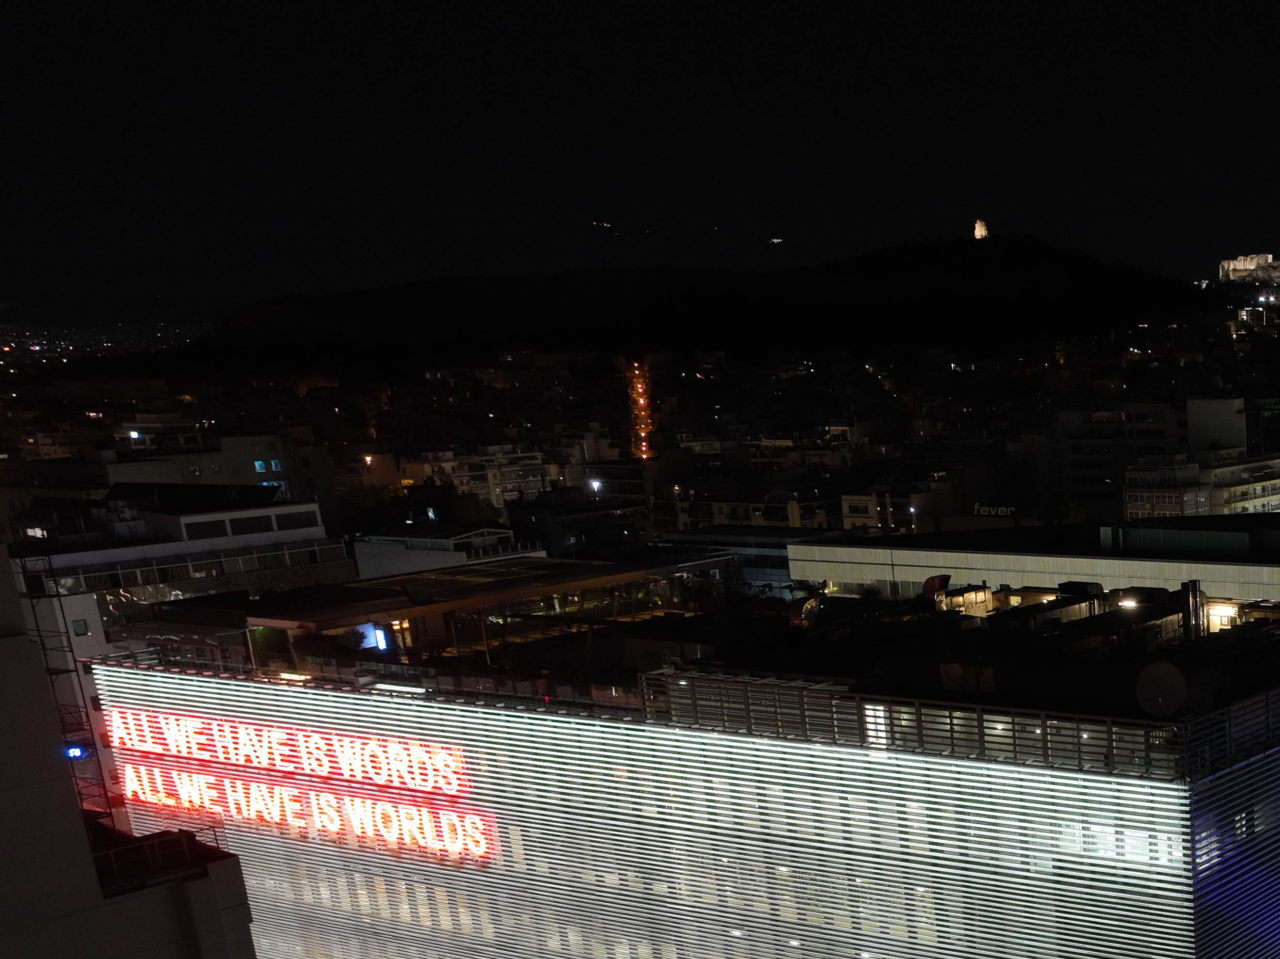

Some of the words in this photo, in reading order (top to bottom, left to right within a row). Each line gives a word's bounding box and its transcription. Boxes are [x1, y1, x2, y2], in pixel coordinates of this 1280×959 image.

[973, 502, 1016, 516] fever
[111, 710, 163, 752] ALL
[159, 715, 210, 760] WE
[212, 722, 295, 771] HAVE
[299, 733, 330, 776] IS
[332, 738, 459, 795] WORDS
[125, 763, 176, 806] ALL
[172, 770, 224, 813] WE
[223, 778, 307, 827] HAVE
[309, 790, 341, 832] IS
[343, 795, 488, 855] WORLDS
